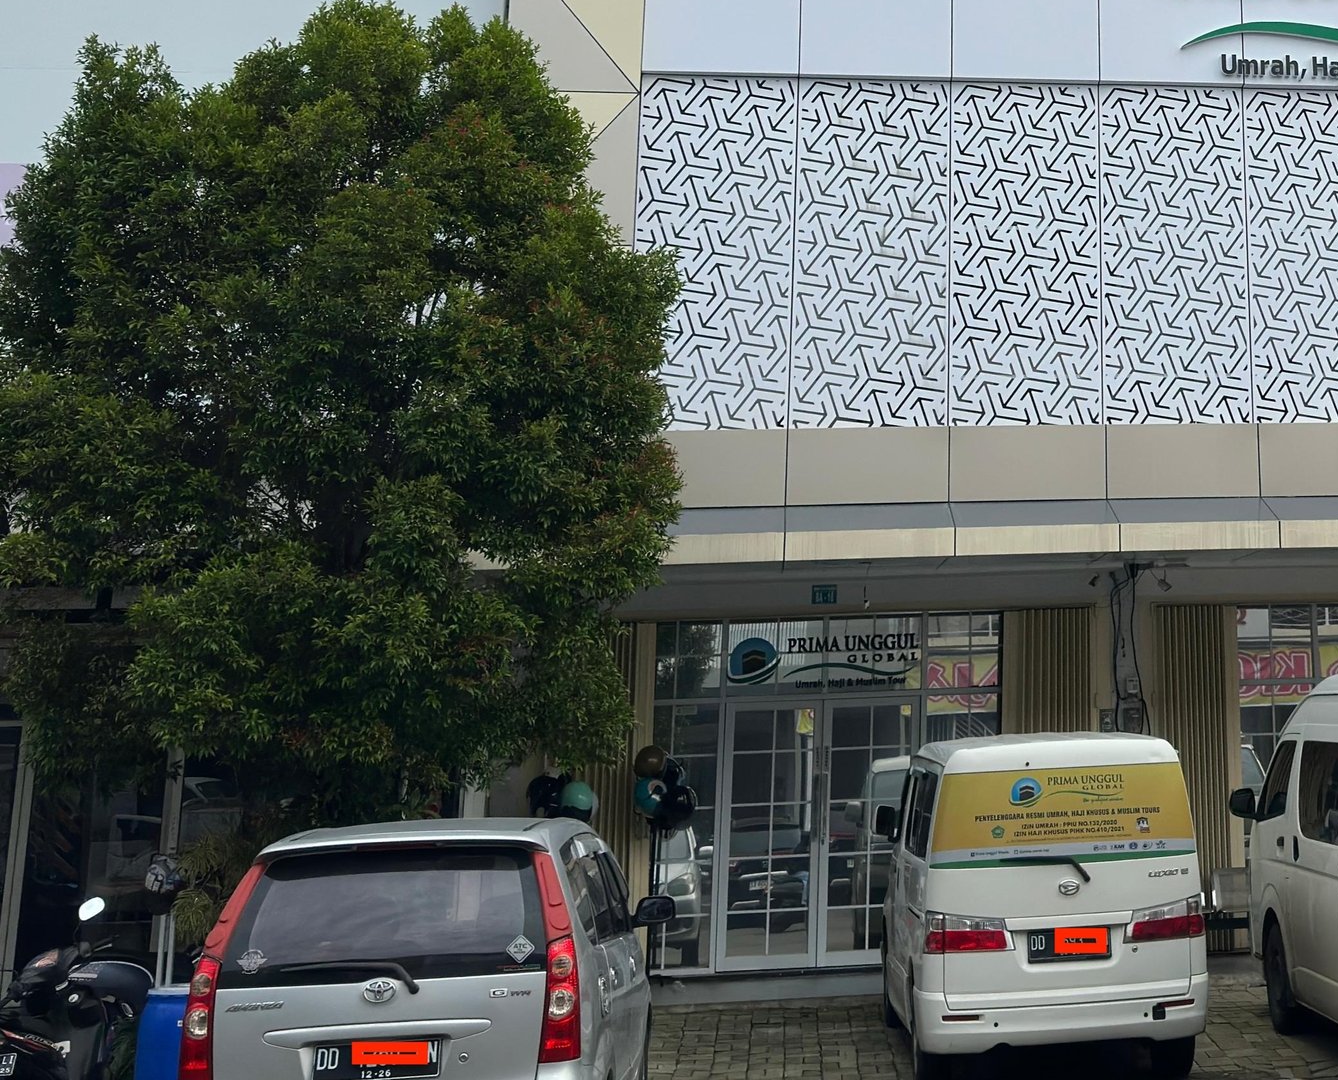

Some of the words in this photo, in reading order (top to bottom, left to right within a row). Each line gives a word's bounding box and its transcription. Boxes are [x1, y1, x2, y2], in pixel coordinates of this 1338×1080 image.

[1220, 53, 1307, 80] Umrah,
[787, 635, 842, 653] PRIMA
[844, 632, 919, 651] UNGGUL
[847, 652, 918, 663] GLOBAL
[1047, 775, 1079, 786] PRIMA
[1081, 773, 1125, 784] UNGGUL
[1082, 783, 1124, 791] GLOBAL
[975, 812, 1025, 822] PENYELENGGARA
[1026, 812, 1045, 820] RESMI
[1071, 809, 1085, 817] HAJI
[1086, 808, 1110, 816] KHUSUS
[1117, 807, 1140, 815] MUSLIM
[1142, 806, 1160, 814] TOURS
[1063, 821, 1077, 829] PPIU
[1013, 830, 1027, 838] IZIN
[1030, 935, 1045, 951] DD
[316, 1048, 340, 1071] DD
